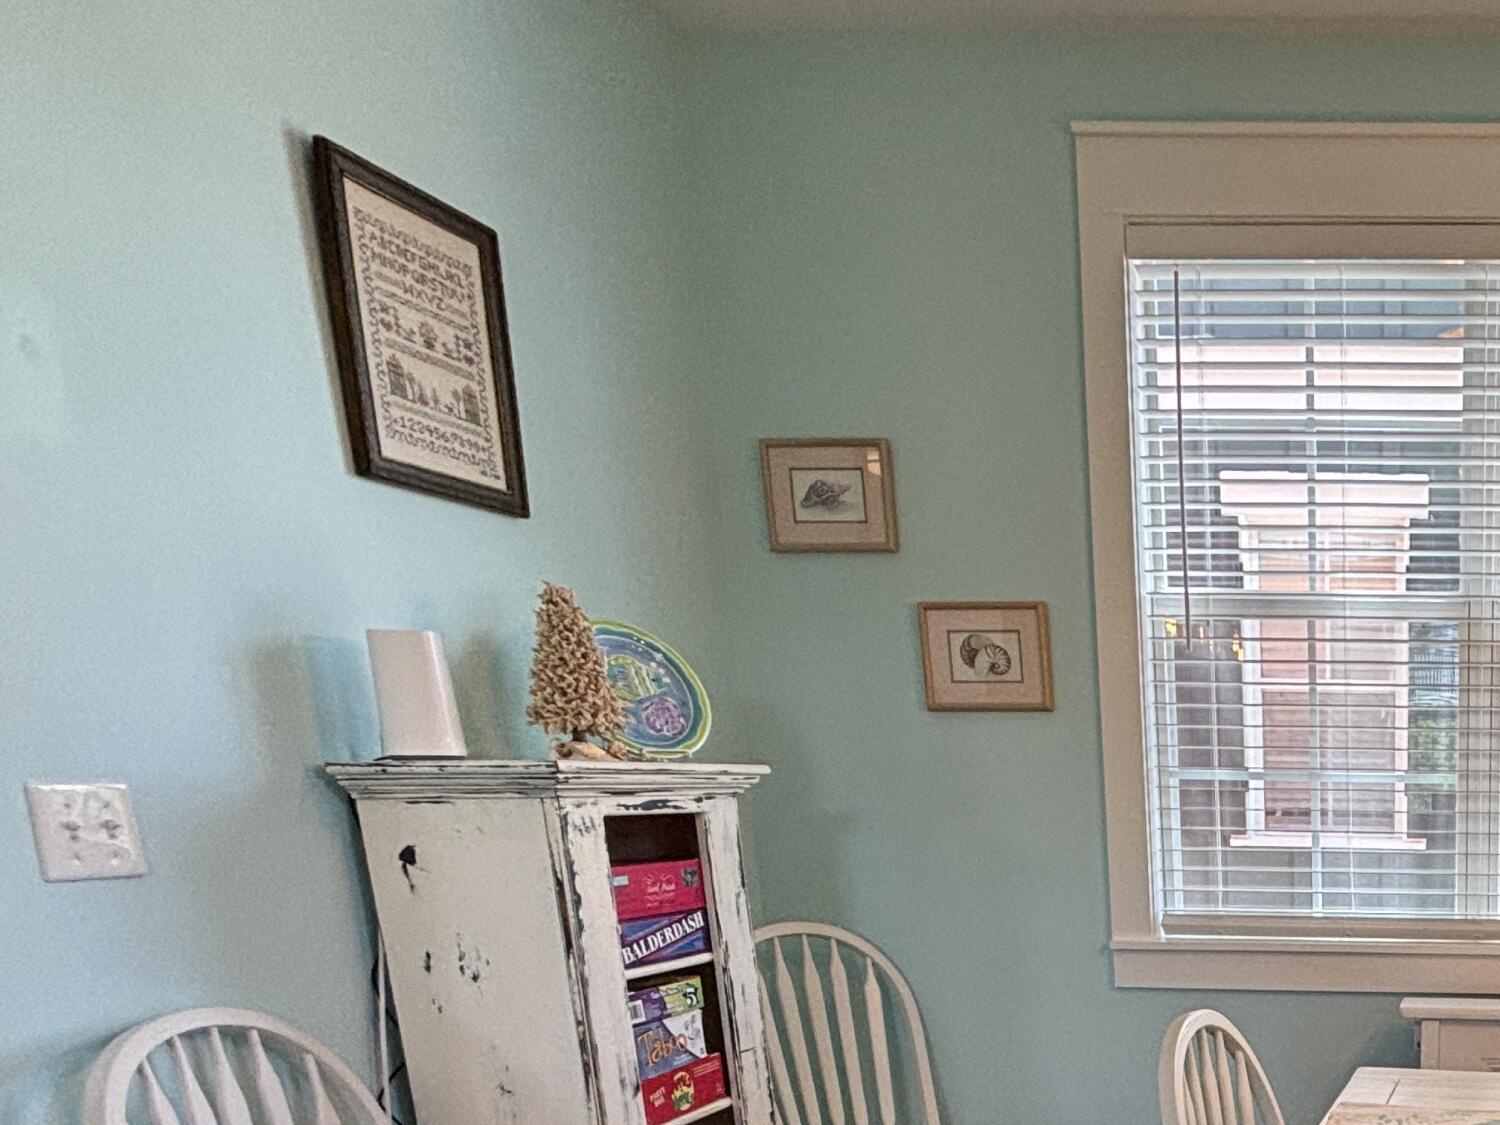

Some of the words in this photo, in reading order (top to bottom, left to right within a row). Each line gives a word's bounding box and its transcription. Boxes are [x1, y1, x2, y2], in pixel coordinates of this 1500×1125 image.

[622, 911, 705, 965] BALDERDASH
[686, 987, 697, 1007] 5
[637, 1027, 687, 1067] Taboo
